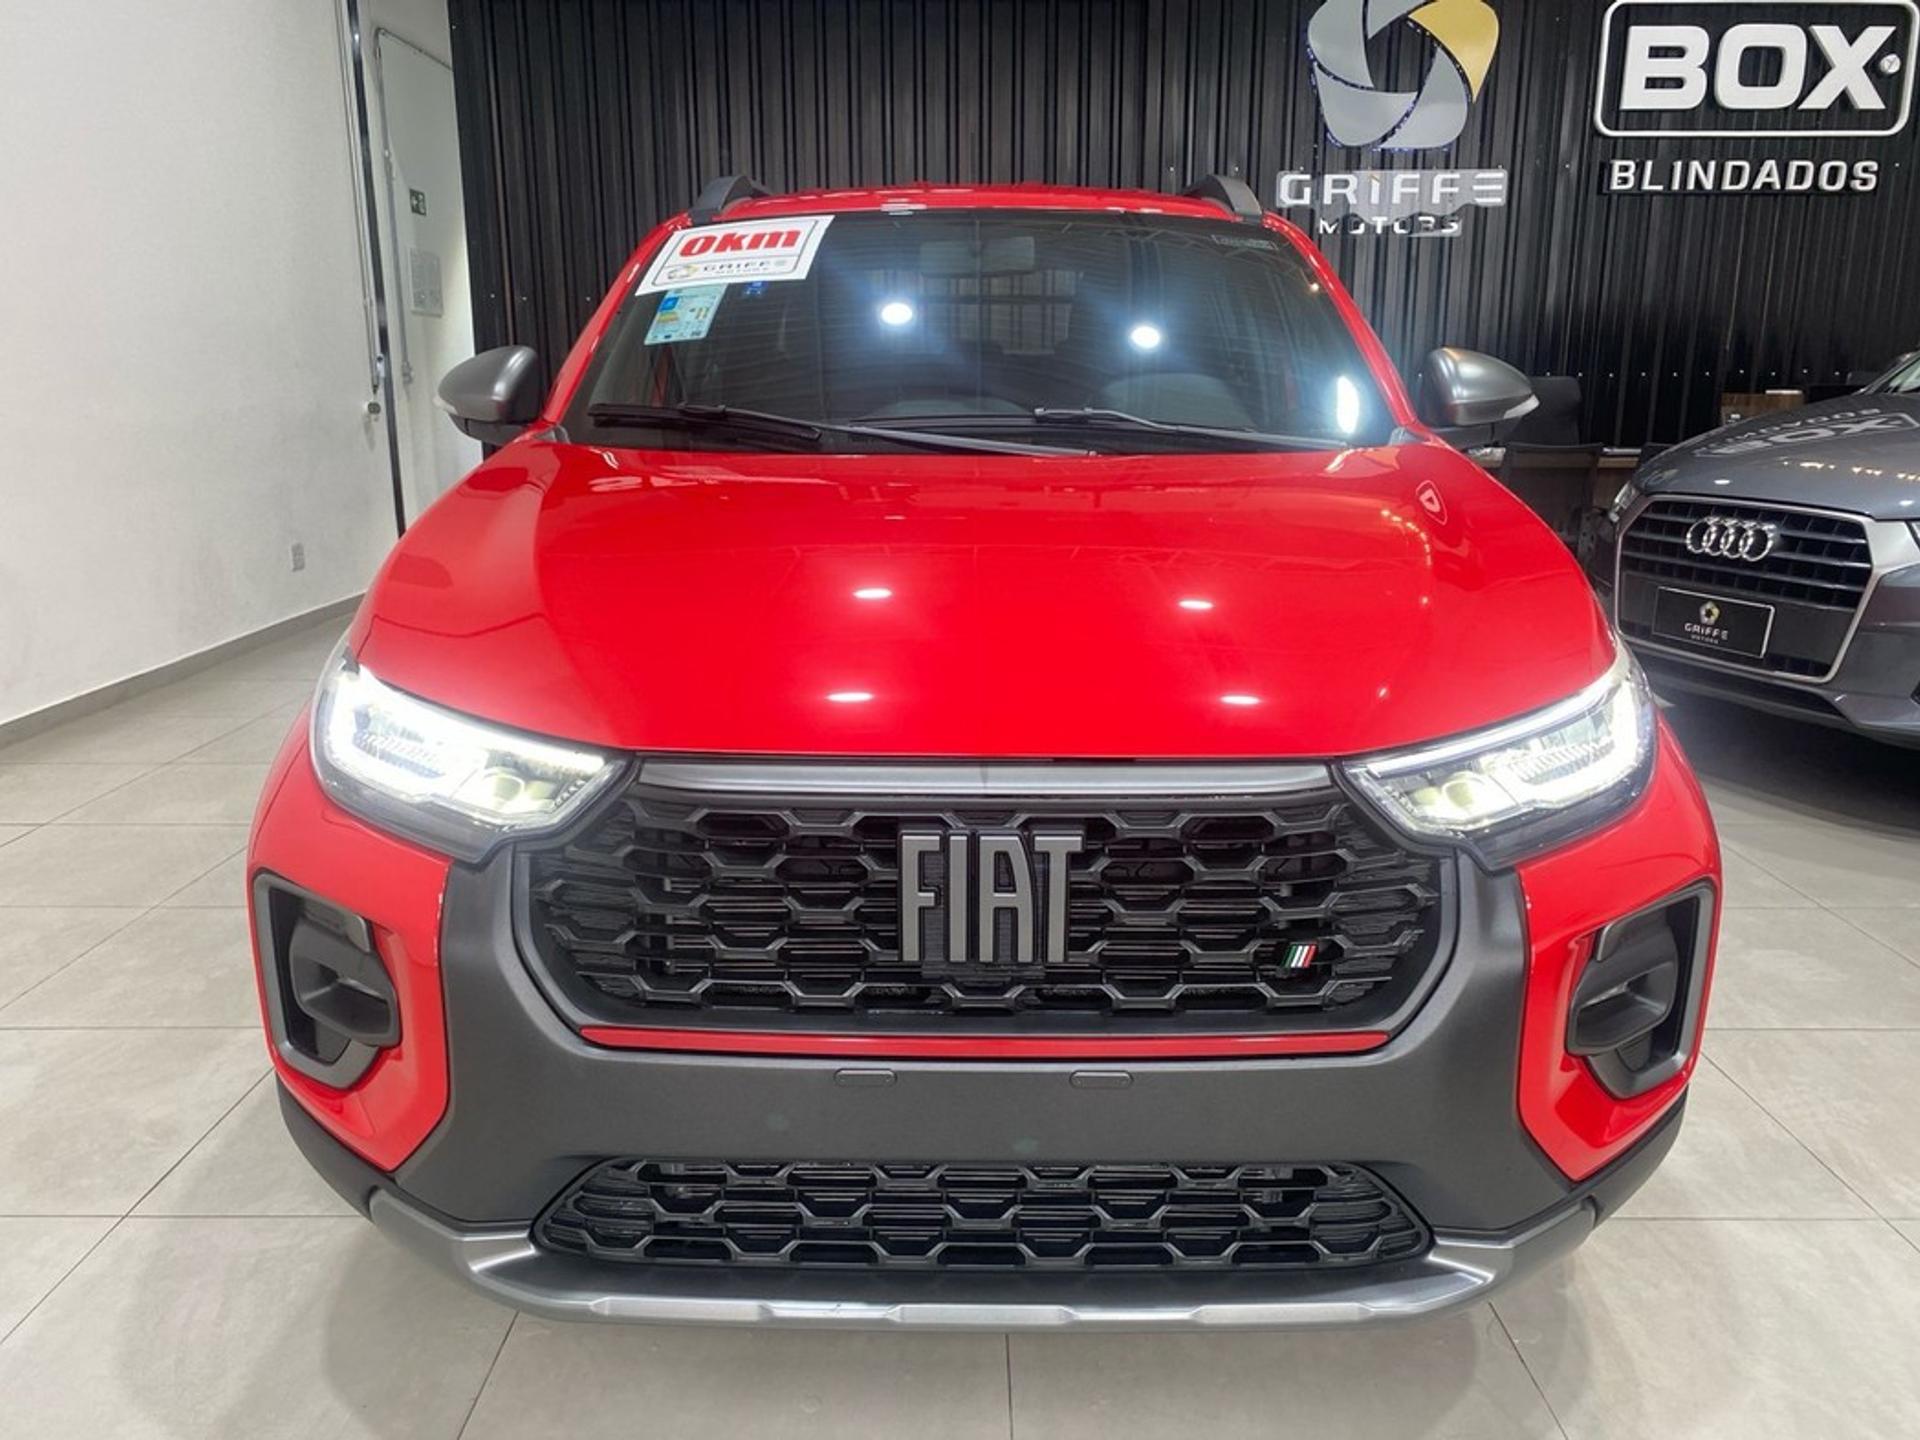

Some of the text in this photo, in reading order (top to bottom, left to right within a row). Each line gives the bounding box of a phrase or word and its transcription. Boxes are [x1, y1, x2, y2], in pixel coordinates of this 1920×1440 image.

[1620, 24, 1896, 110] BOX
[1279, 173, 1504, 204] GRIFFE
[1609, 160, 1879, 191] BLINDADOS
[901, 834, 1083, 963] FIAT
